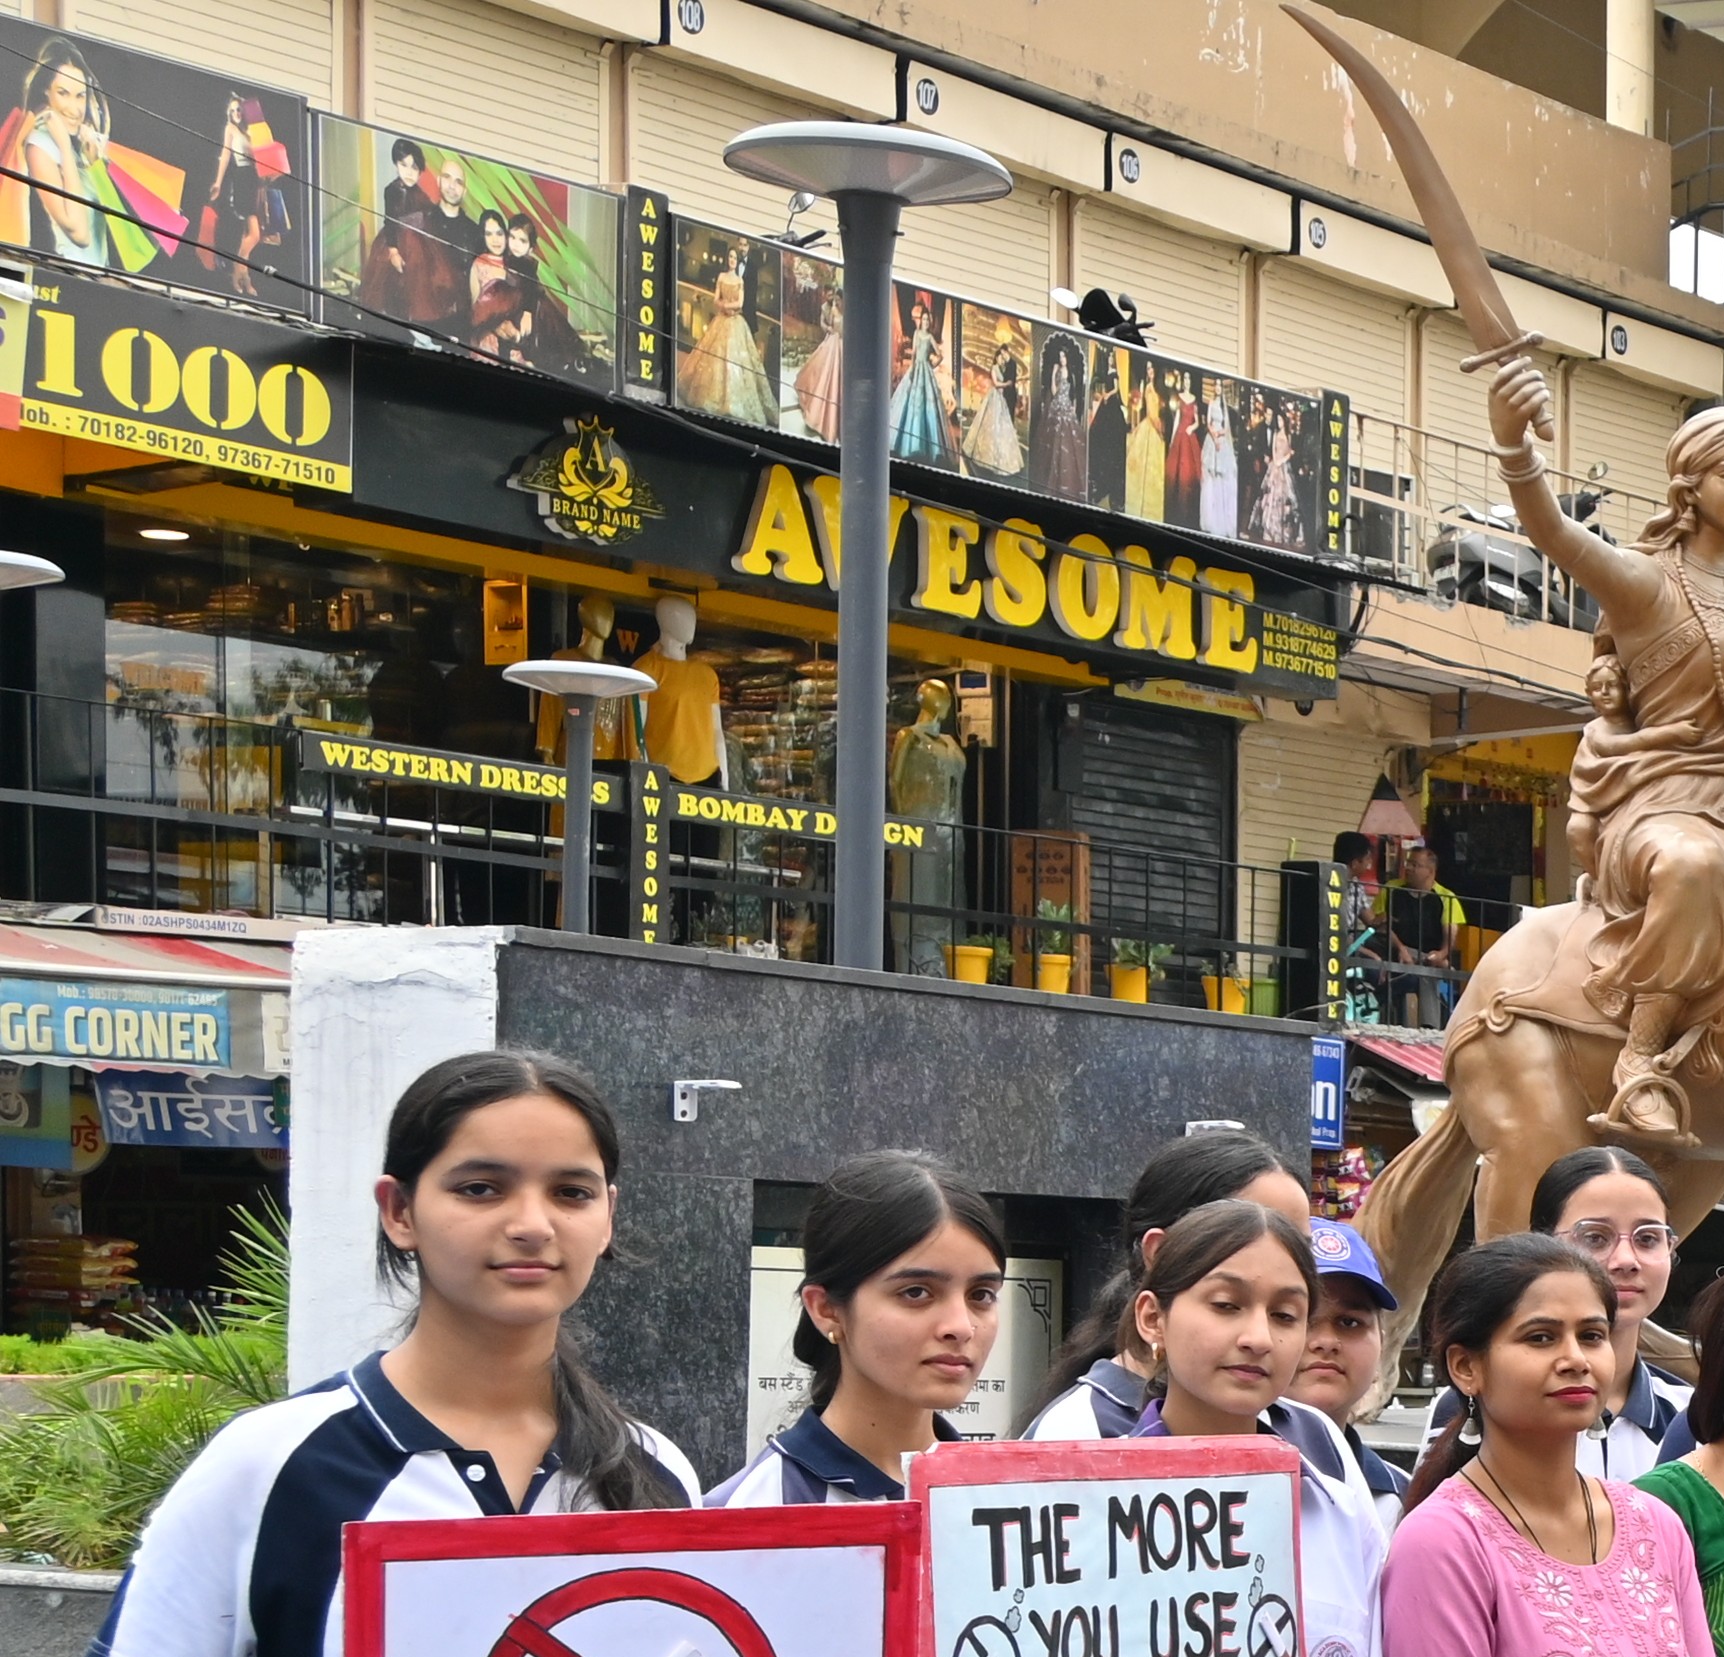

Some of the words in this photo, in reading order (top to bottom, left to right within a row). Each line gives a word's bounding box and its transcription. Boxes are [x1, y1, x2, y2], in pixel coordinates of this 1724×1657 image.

[680, 0, 702, 31] 108
[917, 84, 938, 108] 107
[1121, 155, 1140, 178] 106
[1310, 222, 1326, 244] 105
[639, 197, 658, 381] AWESOME
[36, 309, 332, 447] 1000
[78, 415, 211, 462] 70182-96120,
[218, 448, 337, 486] 97367-71510
[1328, 398, 1344, 550] AWESOME
[553, 497, 599, 521] BRAND
[602, 507, 642, 531] NAME
[320, 739, 472, 787] WESTERN
[480, 763, 610, 805] DRESSS
[678, 793, 804, 831] BOMBAY
[815, 810, 925, 847] DGN
[1327, 869, 1342, 1019] AWESOME
[64, 1005, 220, 1062] CORNER
[972, 1505, 1081, 1591] THE
[1107, 1490, 1251, 1574] MORE
